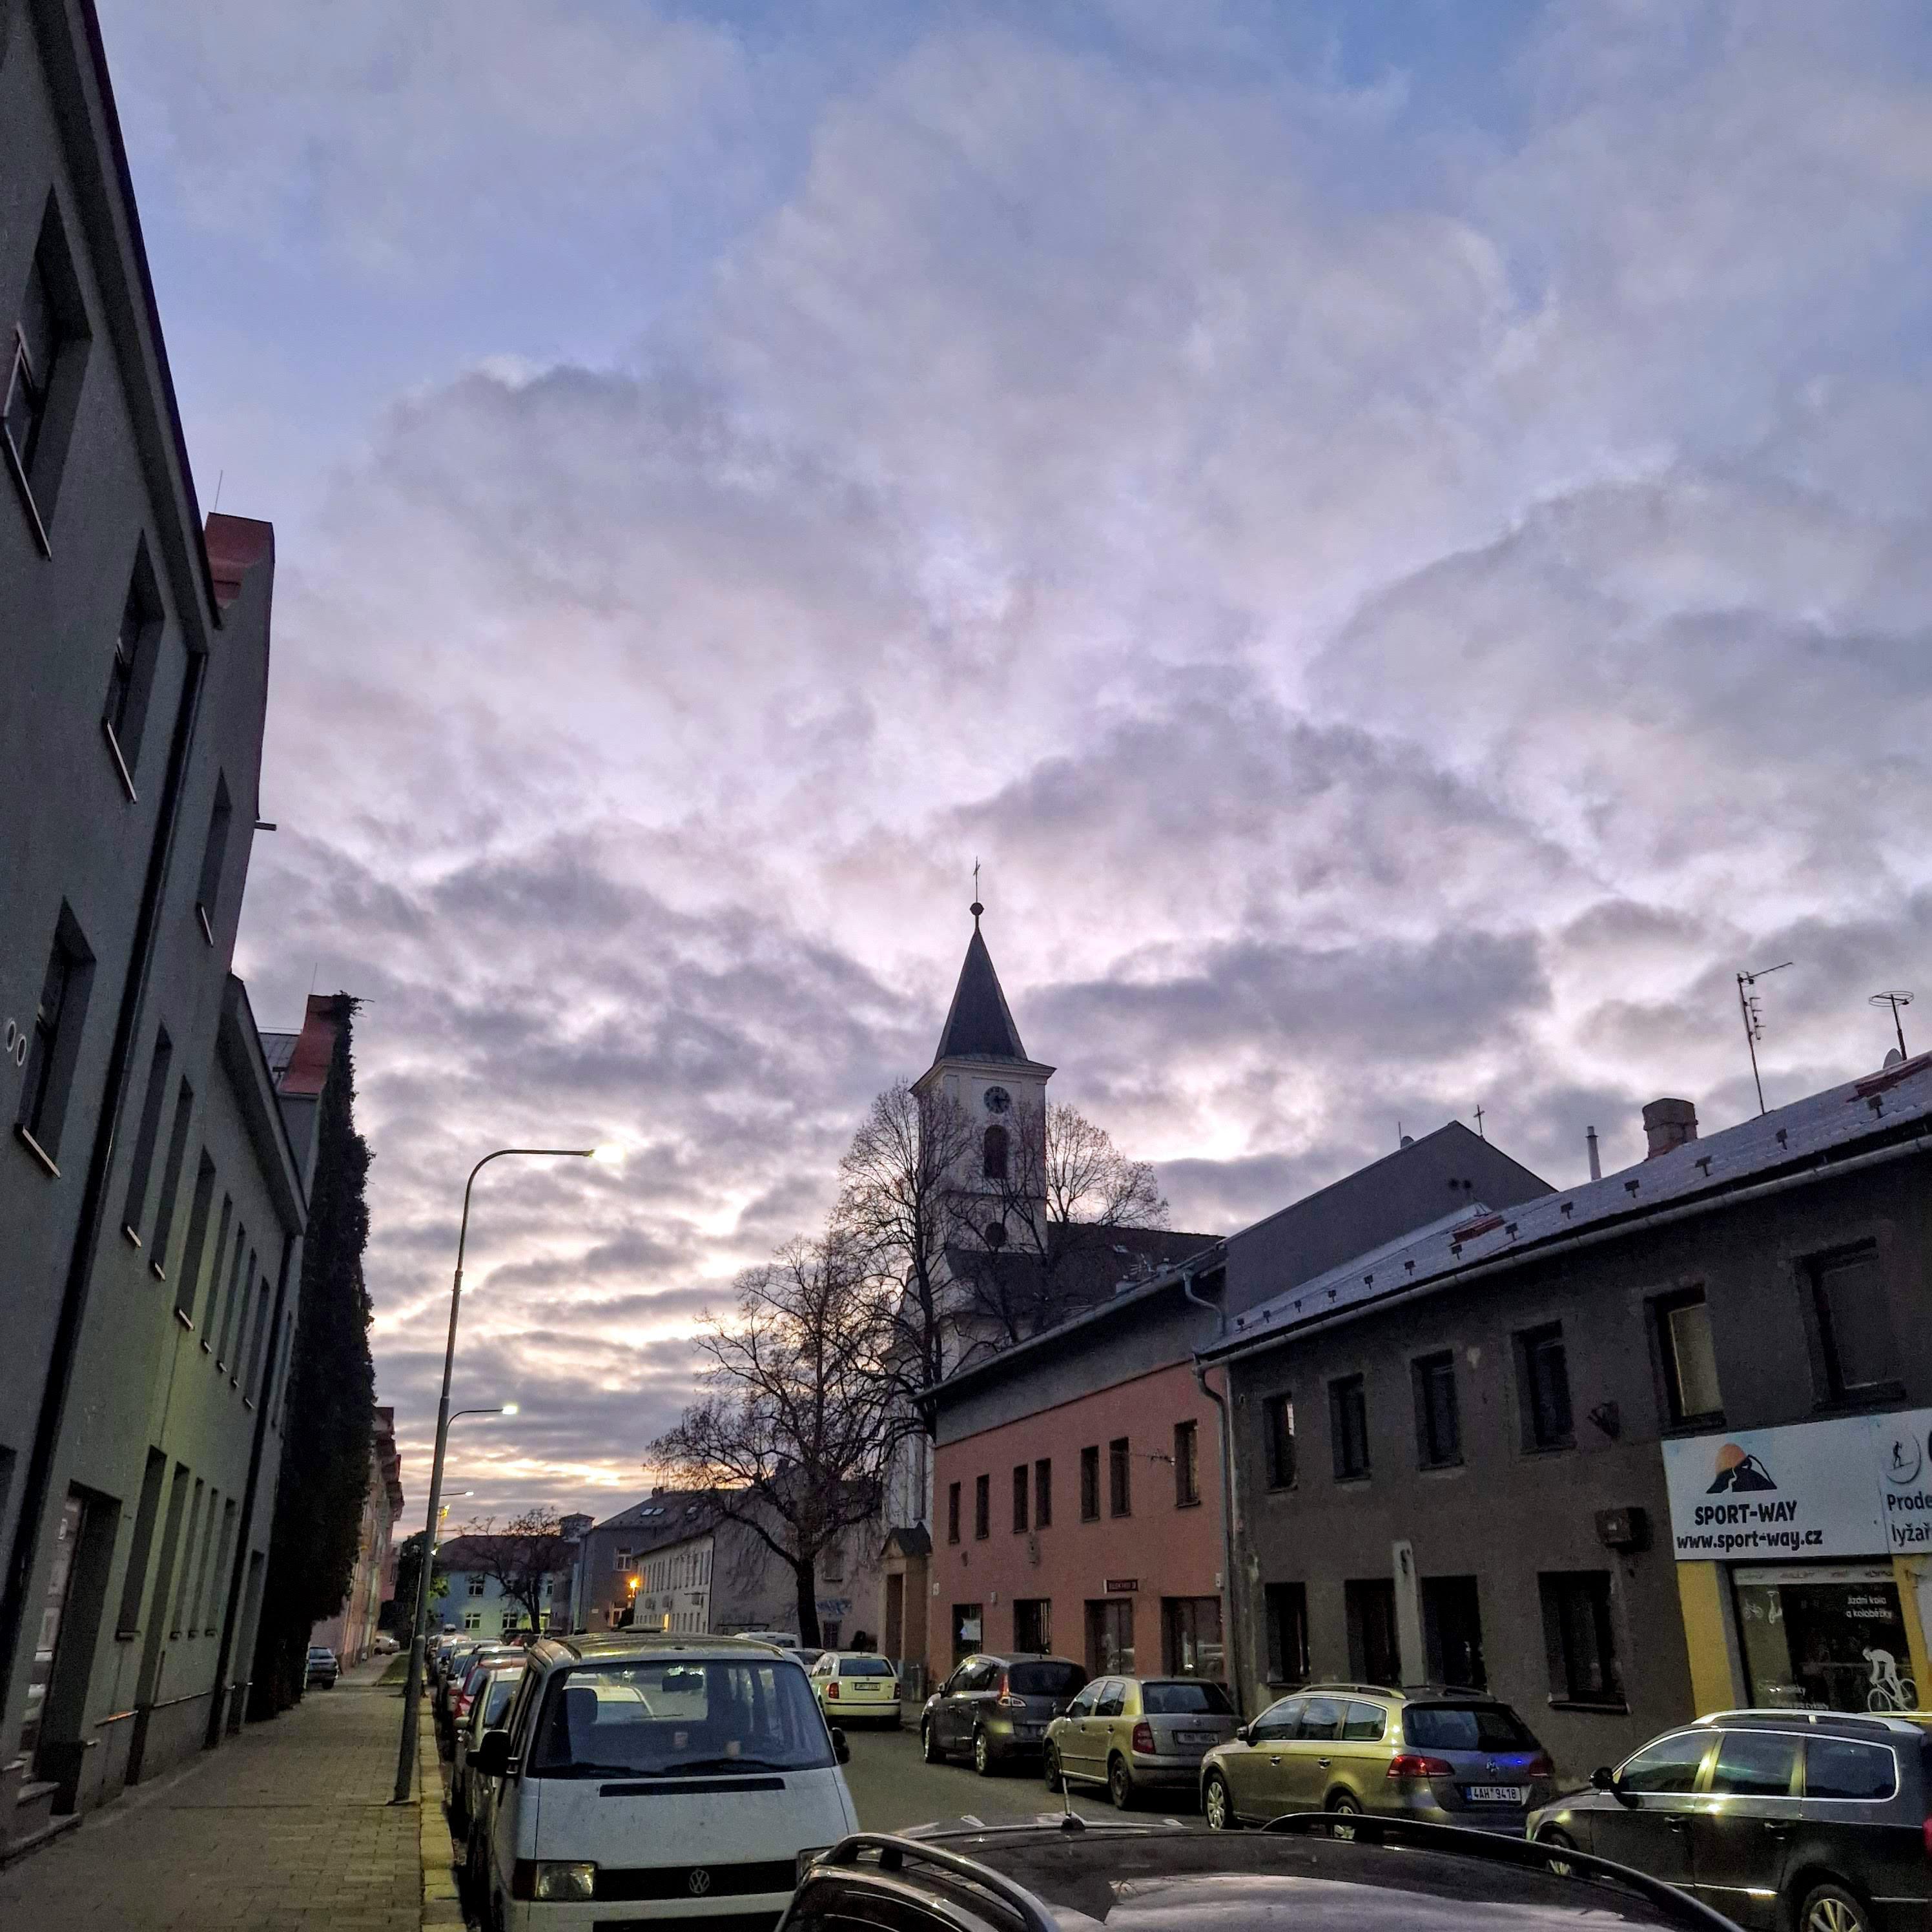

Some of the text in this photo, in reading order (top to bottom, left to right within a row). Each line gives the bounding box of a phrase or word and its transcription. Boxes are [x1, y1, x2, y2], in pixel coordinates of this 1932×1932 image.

[1694, 1500, 1798, 1526] SPORT-WAY
[1677, 1530, 1823, 1552] www.sport-way.cz
[1474, 1788, 1516, 1799] 4AH 9418
